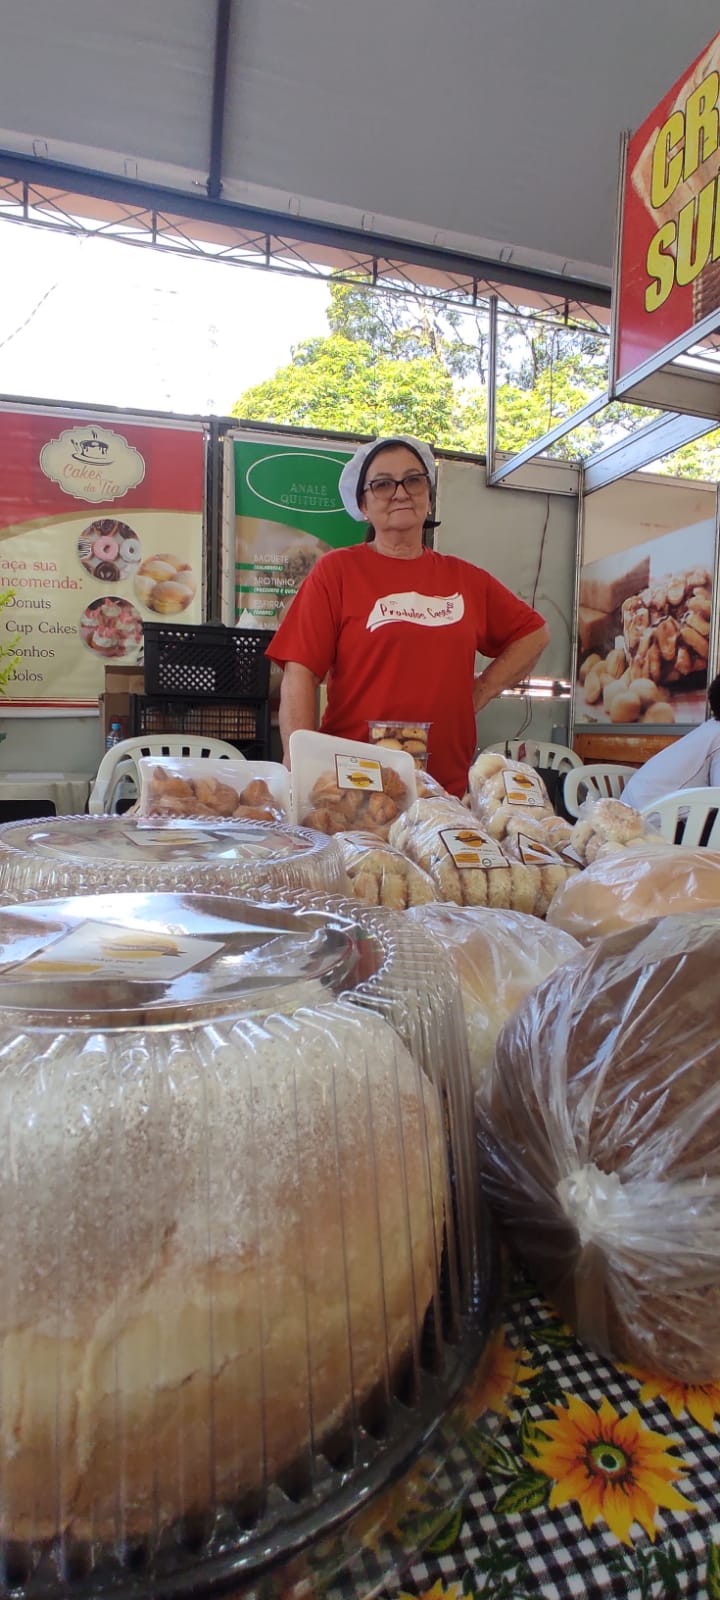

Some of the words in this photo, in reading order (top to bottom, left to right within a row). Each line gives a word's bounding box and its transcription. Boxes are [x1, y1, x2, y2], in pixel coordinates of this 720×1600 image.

[644, 174, 720, 313] SU
[63, 463, 103, 480] Cakes
[290, 483, 328, 496] ANALE
[281, 494, 336, 508] QUITUTES
[0, 559, 27, 573] aça
[32, 561, 57, 572] sua
[0, 575, 83, 590] ncomenda:
[5, 620, 33, 635] Cup
[38, 621, 78, 634] Cakes
